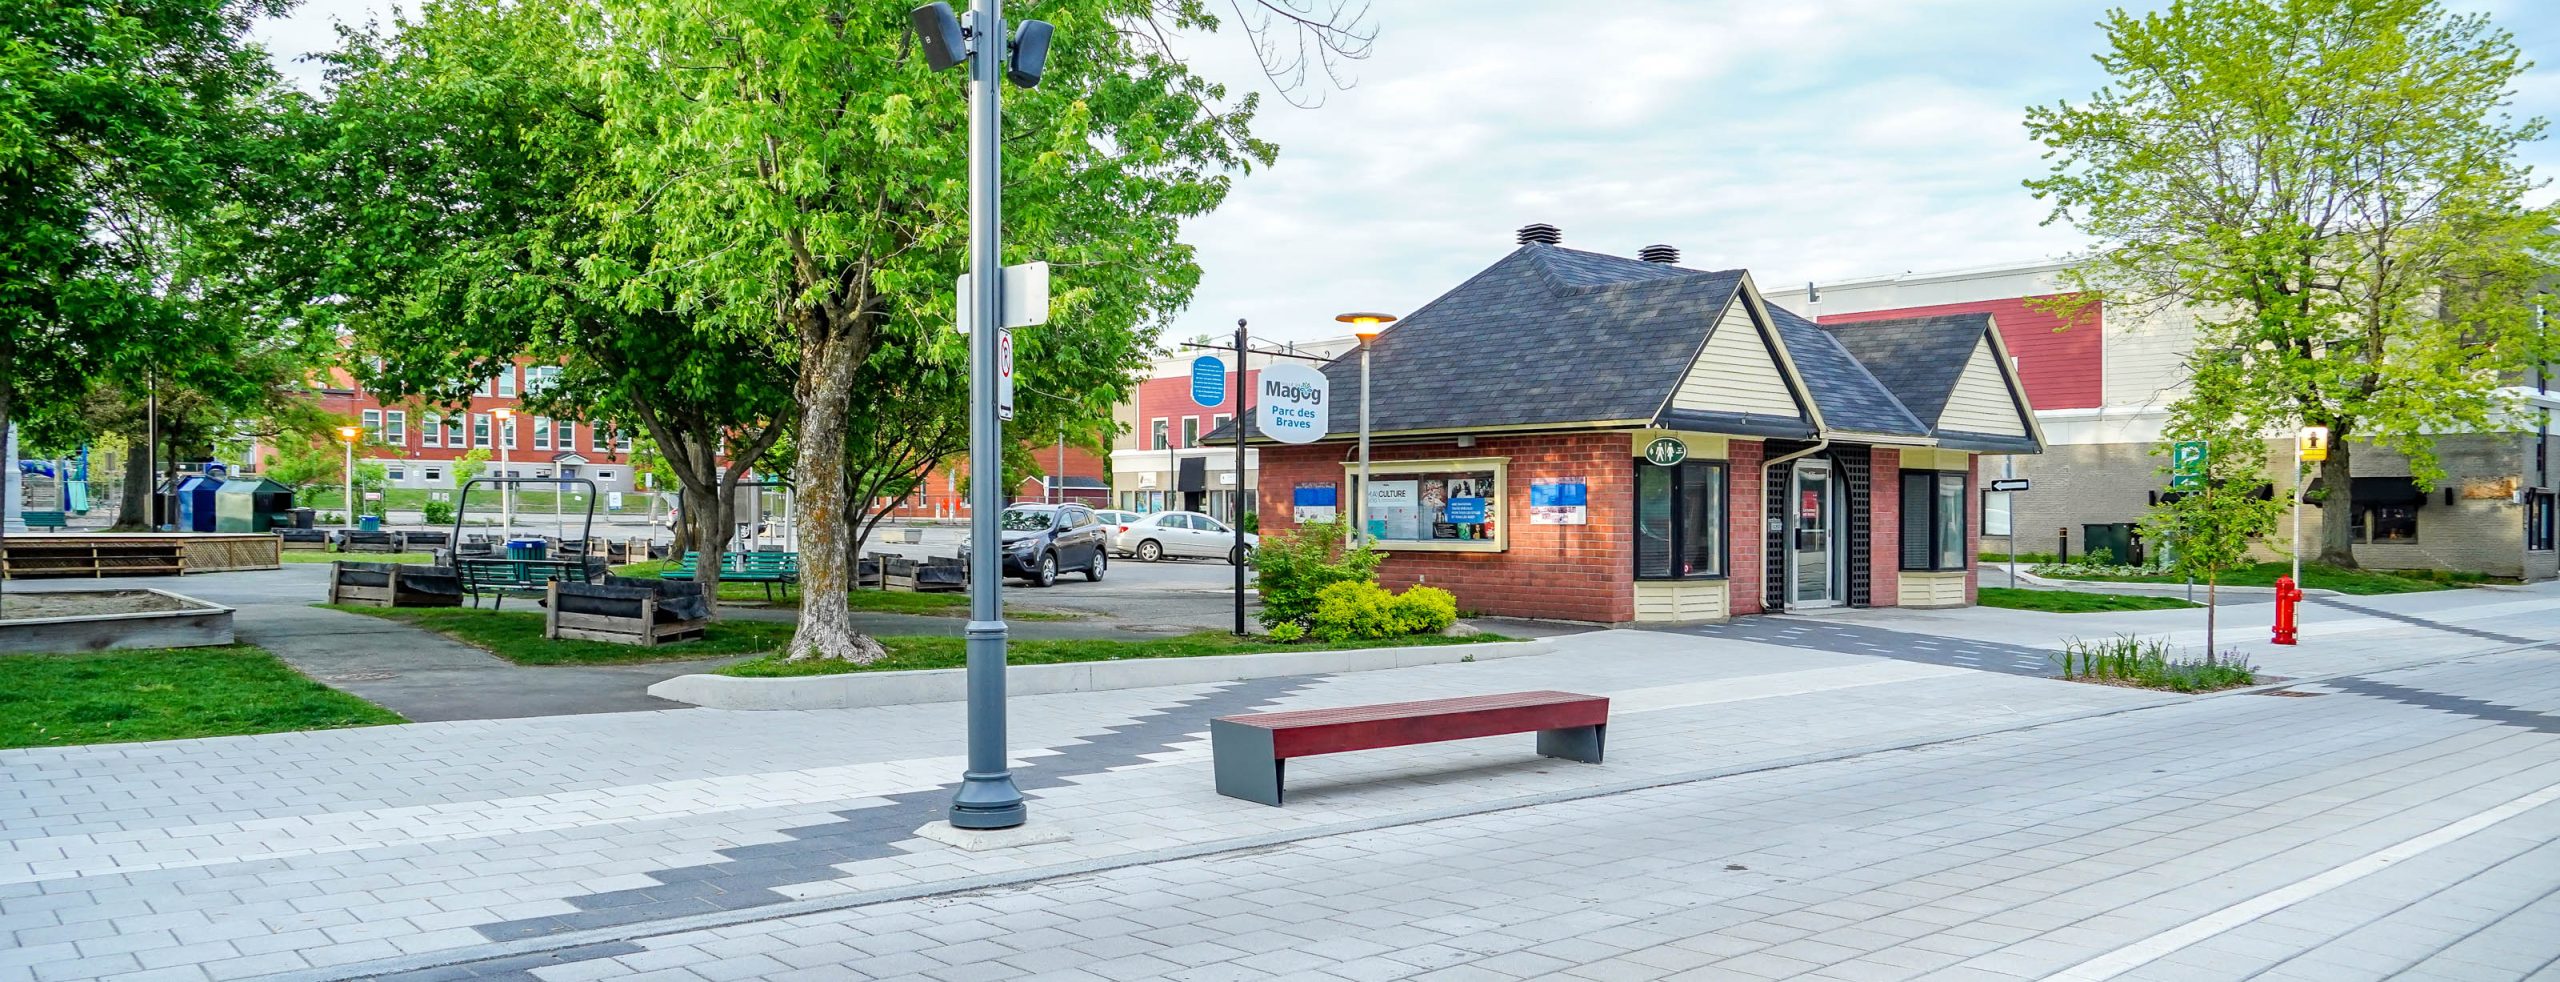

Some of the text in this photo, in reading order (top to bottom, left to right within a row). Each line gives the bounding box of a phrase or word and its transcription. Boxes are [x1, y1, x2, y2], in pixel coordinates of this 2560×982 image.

[1266, 380, 1321, 405] Magog
[1272, 405, 1316, 418] Parc des
[1276, 417, 1311, 429] Braves
[1379, 490, 1406, 498] CULTURE
